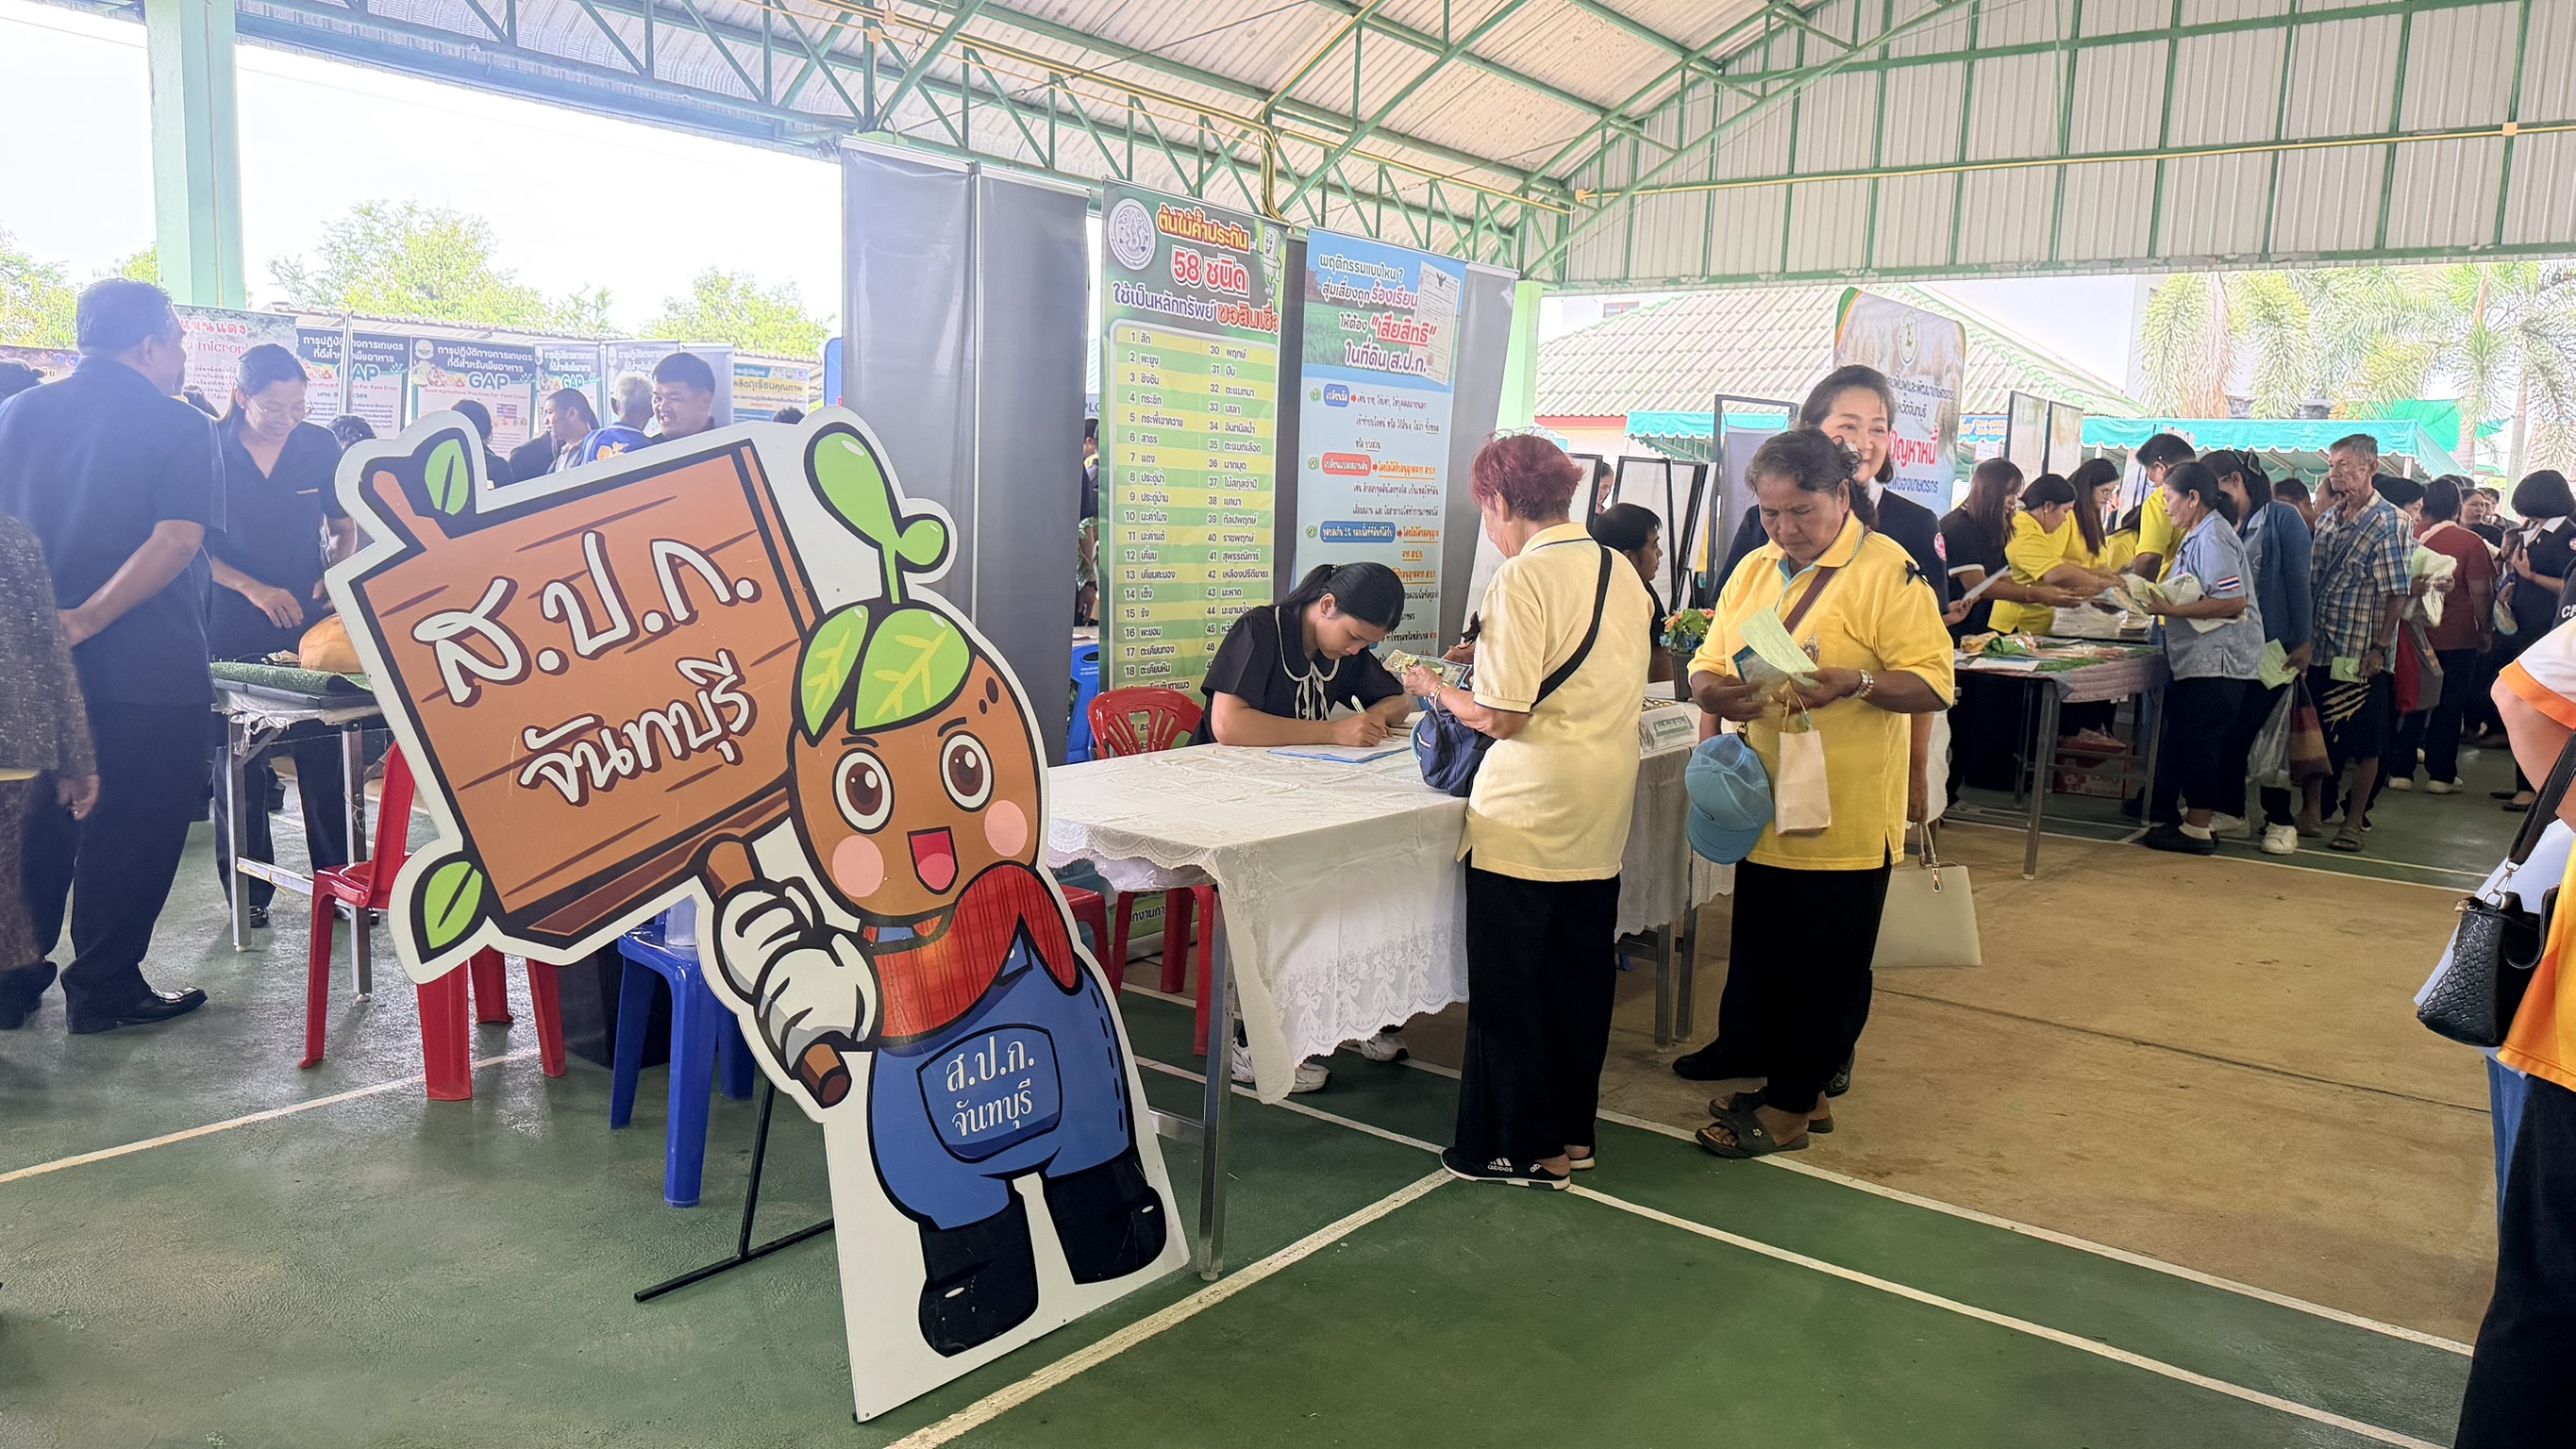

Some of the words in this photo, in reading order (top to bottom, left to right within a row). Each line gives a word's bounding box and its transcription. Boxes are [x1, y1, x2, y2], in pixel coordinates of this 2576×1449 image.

[1158, 205, 1249, 251] ต้นไม้ค้ำประกัน
[1174, 252, 1201, 281] 58
[1206, 258, 1246, 291] ชนิด
[1320, 255, 1396, 280] พฤติกรรมแบบไหน
[1398, 269, 1404, 281] ?
[1322, 277, 1369, 307] สุ่มเสี่ยงถูก
[1371, 282, 1418, 308] ร้องเรียน
[1113, 283, 1215, 319] ใช้เป็นหลักทรัพย์
[1217, 300, 1279, 332] ขอสินเชื่อ
[1340, 313, 1368, 331] ให้ต้อง
[1131, 332, 1135, 341] 1
[1141, 332, 1150, 344] สัก
[1210, 345, 1220, 355] 30
[1226, 348, 1246, 359] พฤกษ์
[1346, 338, 1386, 367] ในที่ดิน
[1390, 351, 1427, 373] ส.ป.ก.
[1129, 353, 1135, 362] 2
[1141, 355, 1159, 367] พะยูง
[1212, 364, 1219, 374] 31
[469, 373, 509, 390] GAP
[561, 375, 584, 389] GAP
[1129, 373, 1135, 382] 3
[1210, 383, 1219, 392] 32
[1225, 386, 1254, 396] ตะแบกนา
[1313, 388, 1318, 399] 1
[1129, 392, 1135, 402] 4
[1210, 402, 1219, 411] 33
[1130, 412, 1135, 422] 5
[1209, 421, 1218, 430] 34
[1129, 433, 1135, 441] 6
[1209, 440, 1218, 449] 35
[1224, 441, 1261, 452] ตะแบกเลือด
[1130, 452, 1135, 461] 7
[1141, 455, 1155, 463] แดง
[1209, 458, 1217, 468] 36
[1310, 457, 1316, 469] 2
[1129, 472, 1135, 481] 8
[1141, 470, 1164, 486] ประดู่ป่า
[1209, 477, 1217, 487] 37
[1129, 491, 1135, 501] 9
[1141, 491, 1168, 506] ประดู่บ้าน
[1208, 496, 1217, 506] 38
[1224, 497, 1241, 506] แคนา
[1126, 511, 1135, 521] 10
[1141, 510, 1167, 522] มะค่าโมง
[1208, 514, 1217, 524] 39
[1223, 514, 1257, 526] กัลปพฤกษ์
[1128, 531, 1135, 541] 11
[1141, 529, 1165, 541] มะค่าแต้
[1308, 526, 1314, 537] 3
[1208, 533, 1217, 541] 40
[1223, 533, 1255, 544] ราชพฤกษ์
[1126, 551, 1135, 559] 12
[1141, 546, 1157, 559] เคี่ยม
[1210, 552, 1216, 560] 41
[1223, 550, 1260, 563] สุพรรณิการ์
[1126, 570, 1135, 579] 13
[1208, 570, 1216, 578] 42
[1126, 590, 1135, 599] 14
[1141, 586, 1152, 598] เต็ง
[1207, 588, 1216, 597] 43
[1126, 608, 1135, 618] 15
[1141, 608, 1149, 618] รัง
[1207, 607, 1215, 615] 44
[412, 531, 757, 705] ส.ป.ก.
[1126, 628, 1135, 638] 16
[1140, 627, 1161, 637] พะยอม
[1207, 625, 1215, 633] 45
[1126, 647, 1135, 657] 17
[1140, 644, 1175, 656] ตะเคียนทอง
[1206, 642, 1215, 651] 46
[1126, 666, 1135, 675] 18
[1140, 663, 1170, 675] ตะเคียนหิน
[519, 649, 752, 805] จันทบุรี
[945, 1036, 1035, 1092] ส.ป.ก.
[951, 1077, 1032, 1137] จันทบุรี
